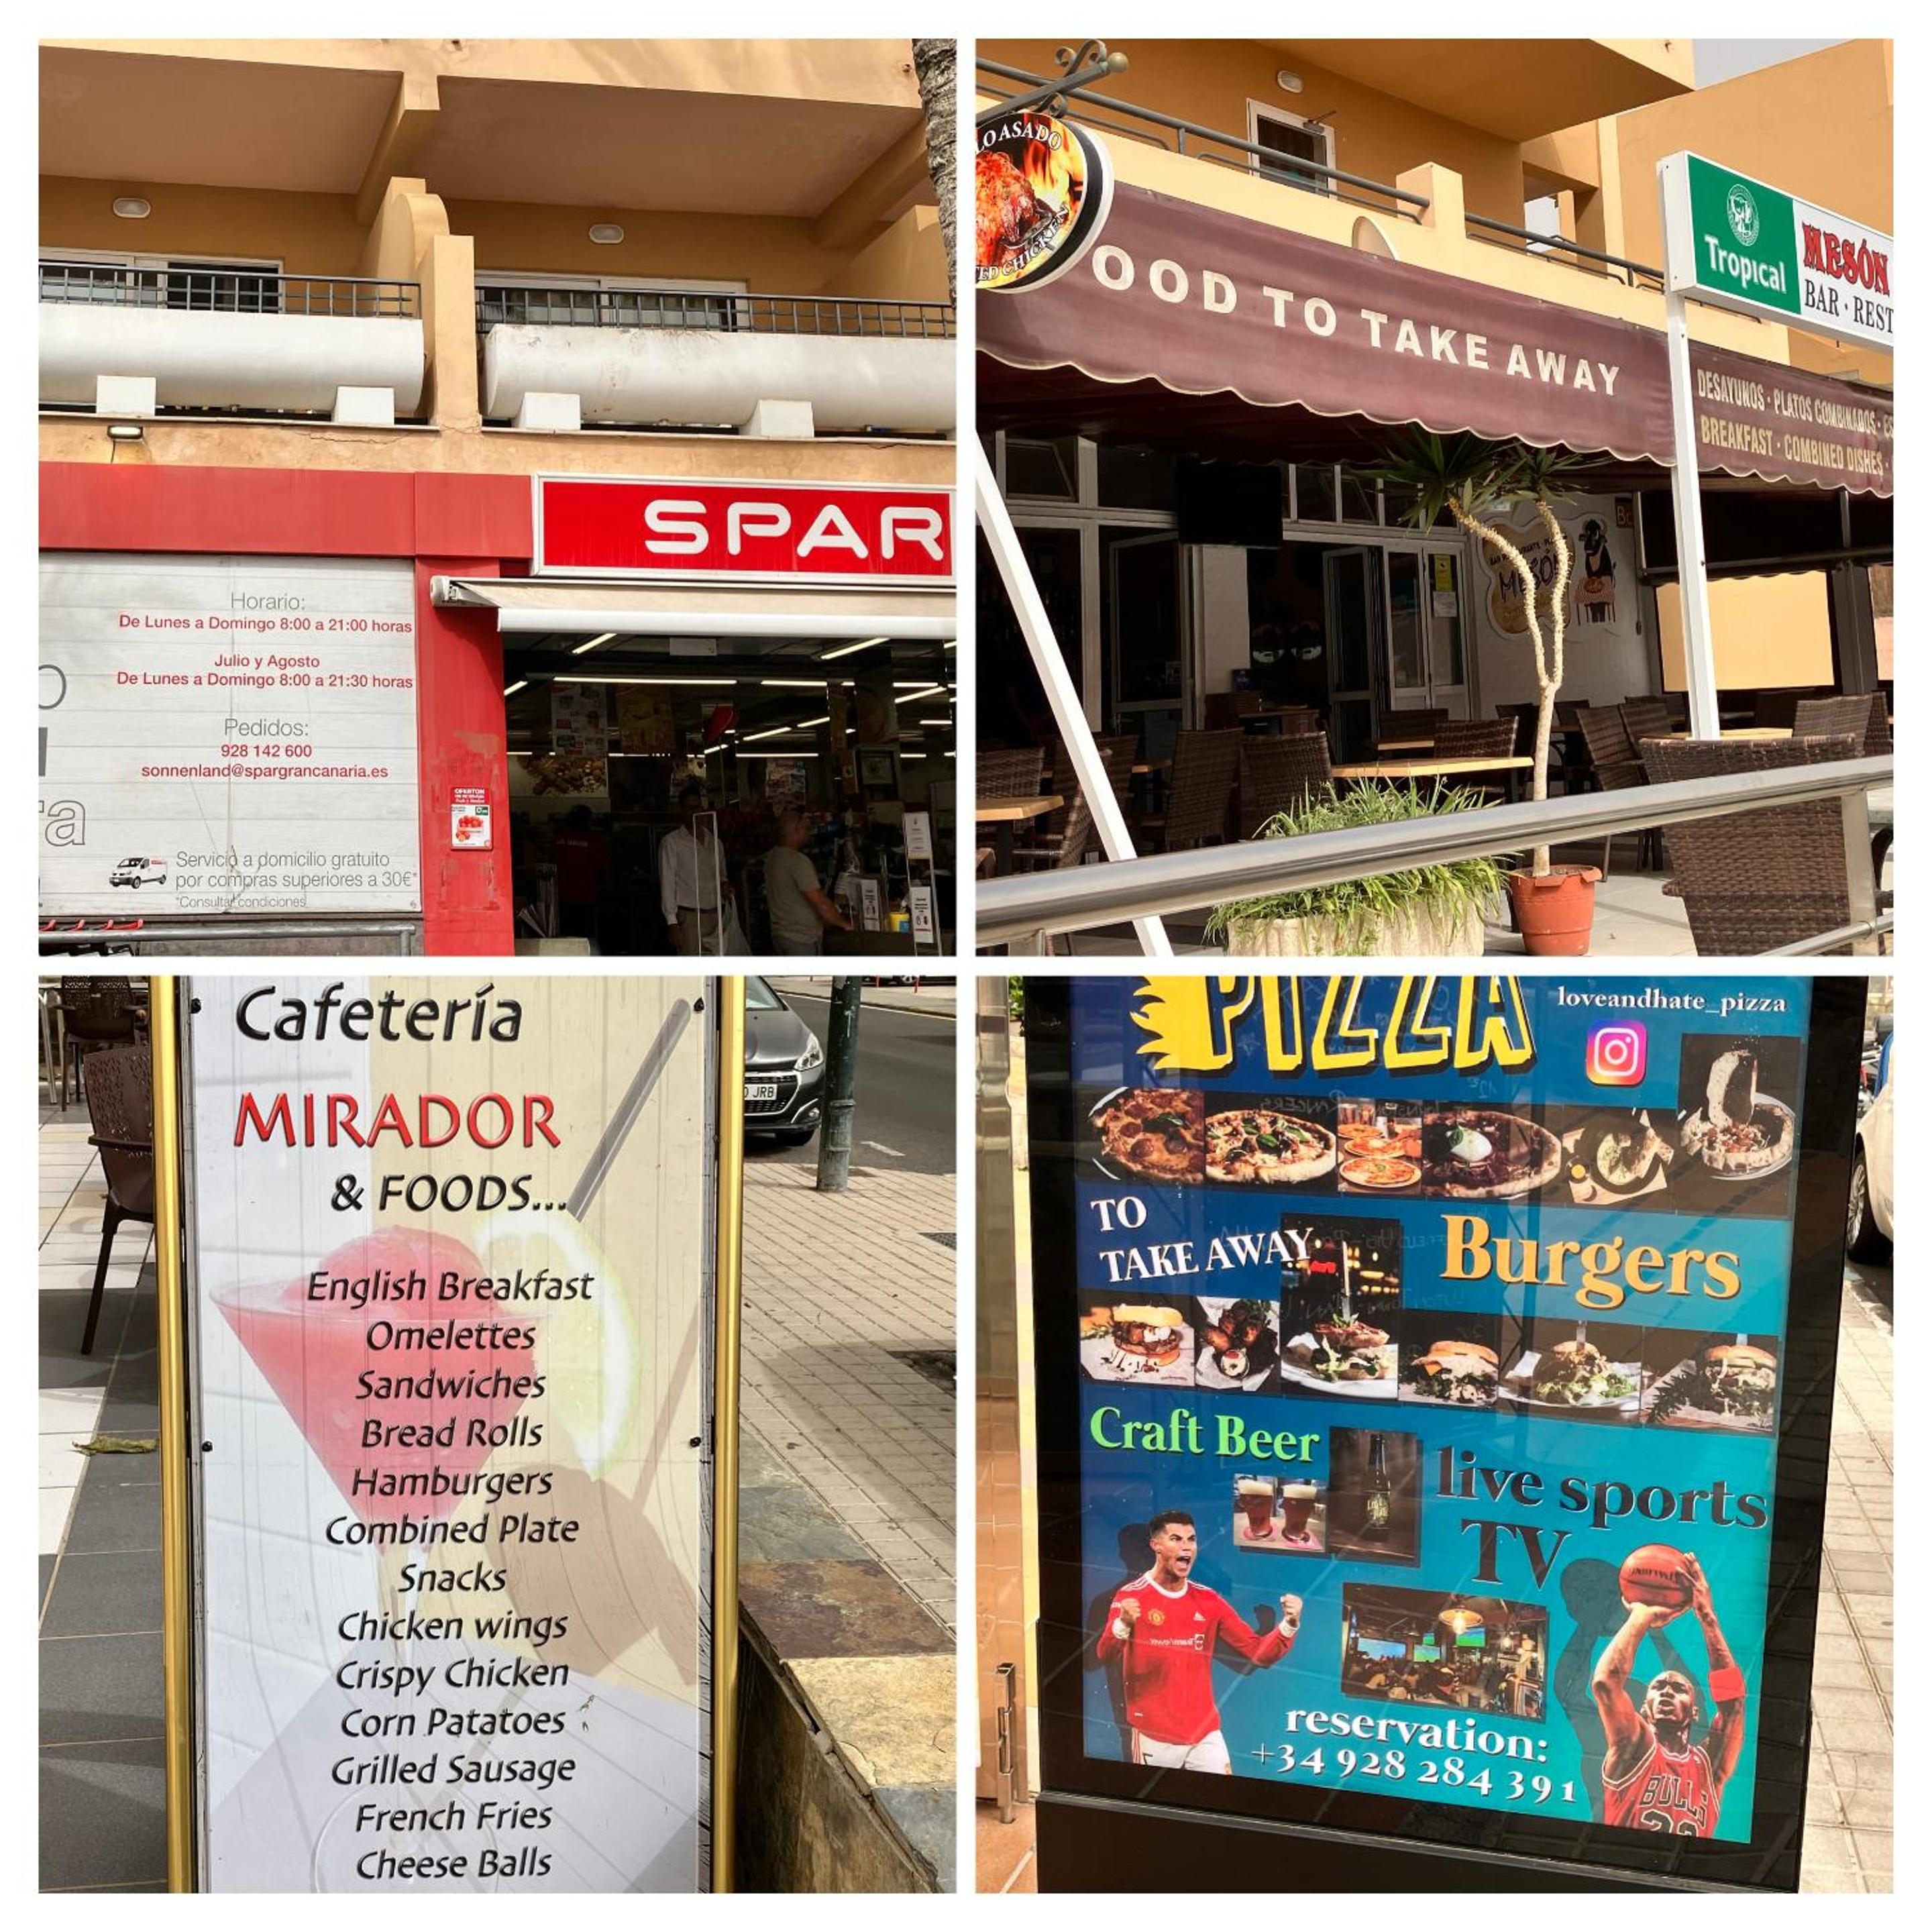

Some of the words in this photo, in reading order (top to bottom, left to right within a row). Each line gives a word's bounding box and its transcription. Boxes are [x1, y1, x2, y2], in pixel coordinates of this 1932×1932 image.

[998, 121, 1062, 151] ASADO
[1002, 205, 1069, 276] CHICKEN
[1704, 234, 1787, 294] Tropical
[1802, 222, 1890, 297] MESÓN
[1091, 245, 1237, 314] OOD
[1263, 286, 1337, 337] TO
[1361, 309, 1489, 370] TAKE
[1506, 343, 1620, 396] AWAY
[1805, 279, 1839, 317] BAR
[1853, 295, 1893, 334] REST
[1697, 368, 1765, 411] DESAYUNOS
[1773, 388, 1813, 422] PLATOS
[1815, 398, 1876, 435] COMBINADOS
[1701, 415, 1773, 456] BREAKFAST
[1784, 434, 1844, 470] COMBINED
[1847, 445, 1884, 476] DISHES
[645, 499, 944, 561] SPAR
[231, 592, 305, 610] Horario:
[119, 614, 140, 628] De
[145, 615, 190, 629] Lunes
[195, 619, 204, 629] a
[209, 616, 275, 633] Domingo
[280, 618, 311, 631] 8:00
[315, 621, 324, 631] a
[329, 619, 368, 631] 21:00
[372, 620, 413, 633] horas
[117, 672, 138, 684] De
[143, 672, 189, 685] Lunes
[193, 676, 202, 685] a
[208, 673, 275, 688] Domingo
[280, 674, 311, 686] 8:00
[315, 677, 324, 686] a
[329, 674, 368, 687] 21:30
[373, 675, 413, 688] horas
[215, 654, 250, 667] Julio
[254, 657, 263, 669] y
[268, 655, 320, 669] Agosto
[225, 718, 309, 737] Pedidos:
[221, 745, 248, 757] 928
[254, 745, 280, 757] 142
[285, 745, 312, 757] 600
[142, 764, 388, 780] sonnenland@spargrancanaria.es
[176, 851, 237, 867] Servicio
[243, 855, 253, 867] a
[258, 851, 327, 867] domicilio
[331, 852, 390, 871] gratuito
[176, 875, 203, 890] por
[208, 875, 277, 890] compras
[283, 872, 362, 890] superiores
[368, 875, 378, 886] a
[238, 896, 306, 908] condiciones
[235, 981, 523, 1042] Cafetería
[1557, 986, 1786, 1016] loveandhate_pizza
[1140, 976, 1536, 1075] PIZZA
[753, 1086, 775, 1098] JRB
[233, 1091, 561, 1148] MIRADOR
[331, 1174, 364, 1212] &
[378, 1174, 567, 1212] FOODS...
[1090, 1195, 1147, 1232] TO
[1099, 1241, 1199, 1283] TAKE
[1205, 1227, 1315, 1271] AWAY
[1440, 1214, 1741, 1310] Burgers
[307, 1269, 427, 1309] English
[439, 1268, 595, 1301] Breakfast
[366, 1319, 536, 1350] Omelettes
[356, 1367, 547, 1399] Sandwiches
[362, 1416, 456, 1448] Bread
[466, 1415, 543, 1448] Rolls
[1089, 1407, 1205, 1454] Craft
[1215, 1413, 1320, 1462] Beer
[352, 1464, 553, 1503] Hamburgers
[1437, 1446, 1544, 1507] live
[1559, 1475, 1769, 1529] sports
[326, 1513, 488, 1545] Combined
[499, 1512, 580, 1543] Plate
[1460, 1518, 1572, 1591] TV
[398, 1561, 506, 1592] Snacks
[338, 1610, 462, 1642] Chicken
[475, 1610, 569, 1647] wings
[336, 1660, 435, 1697] Crispy
[445, 1656, 569, 1688] Chicken
[341, 1709, 415, 1737] Corn
[427, 1707, 566, 1736] Patatoes
[1285, 1708, 1548, 1763] reservation:
[331, 1753, 438, 1784] Grilled
[445, 1755, 576, 1789] Sausage
[1251, 1743, 1325, 1775] +34
[1338, 1748, 1407, 1780] 928
[1417, 1756, 1493, 1796] 284
[1506, 1771, 1577, 1804] 391
[356, 1801, 465, 1832] French
[477, 1800, 553, 1830] Fries
[1639, 1774, 1709, 1829] BULLS
[357, 1849, 468, 1879] Cheese
[478, 1846, 552, 1878] Balls
